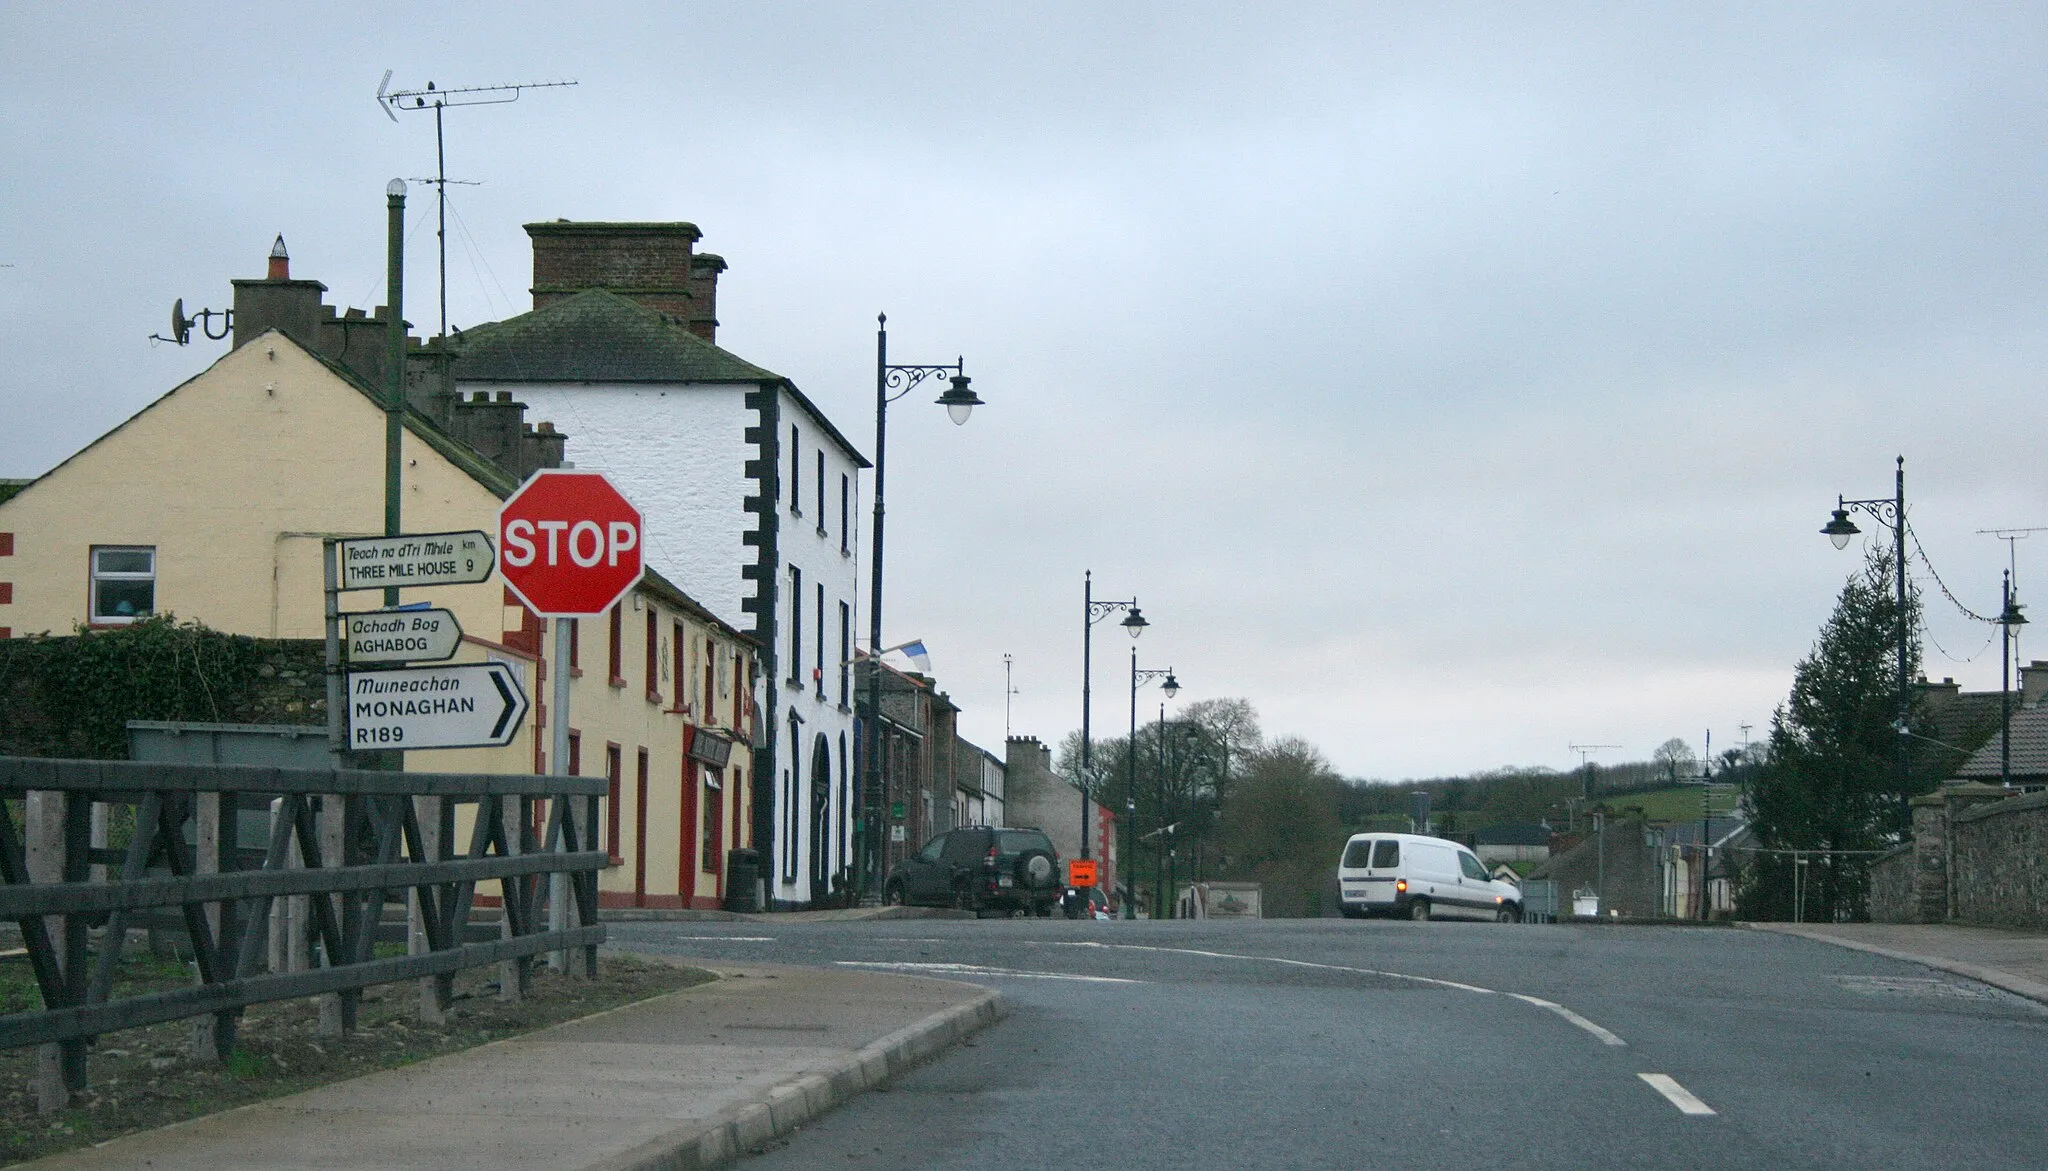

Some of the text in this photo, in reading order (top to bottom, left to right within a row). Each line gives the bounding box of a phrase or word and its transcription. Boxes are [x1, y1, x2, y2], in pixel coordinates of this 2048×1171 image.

[463, 540, 476, 550] km
[504, 518, 637, 568] STOP
[348, 547, 378, 560] Teach
[381, 548, 395, 558] na
[350, 561, 457, 580] THREE MILE HOUSE
[466, 559, 474, 572] 9
[412, 618, 440, 632] Bog
[354, 637, 428, 654] AGHABOG
[356, 697, 474, 718] MONAGHAN
[356, 726, 404, 743] R189
